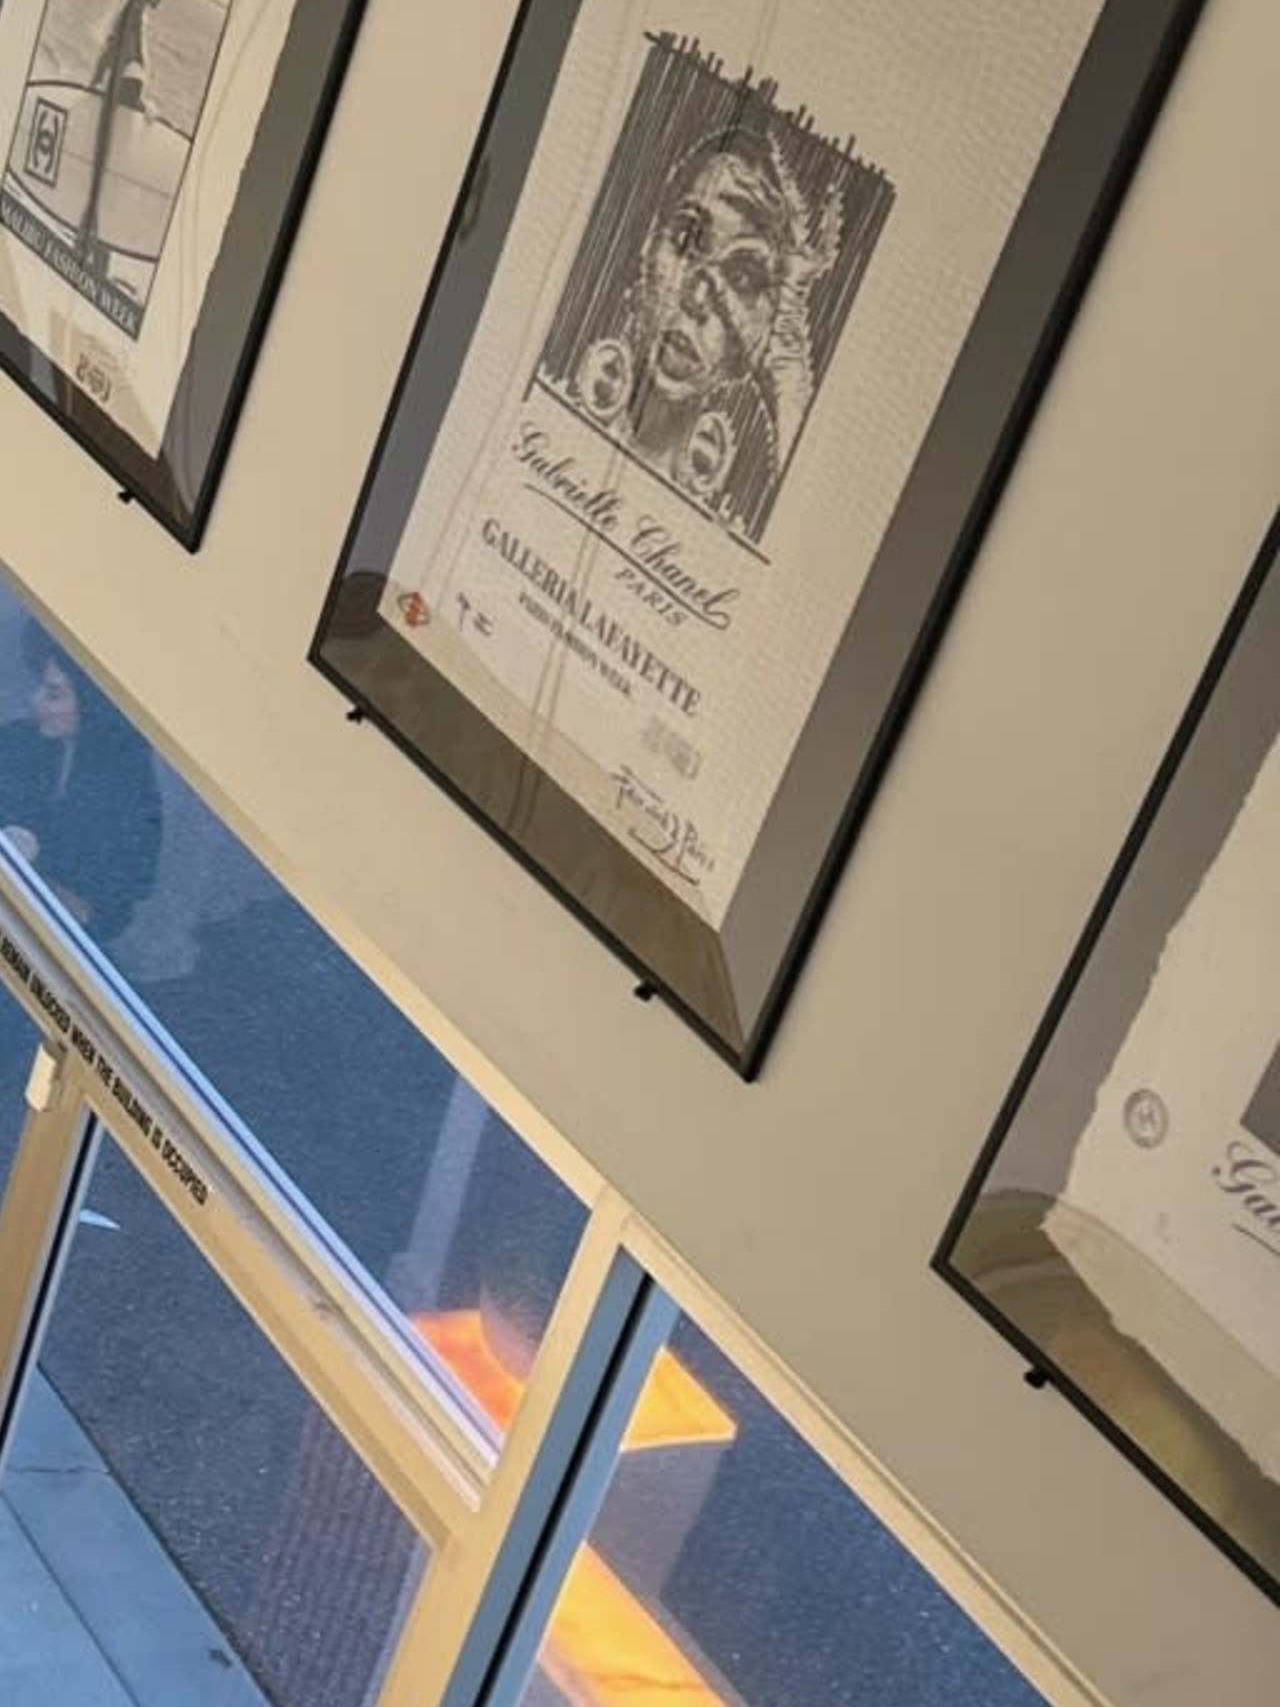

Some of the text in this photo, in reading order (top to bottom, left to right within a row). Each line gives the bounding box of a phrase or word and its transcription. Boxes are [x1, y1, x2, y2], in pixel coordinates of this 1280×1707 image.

[512, 421, 741, 622] Gabrielle Chanel
[482, 518, 577, 616] GALLERIA
[579, 600, 701, 717] LAFAYETTE
[614, 568, 688, 627] PARIS
[161, 1138, 209, 1206] OCCUPIED
